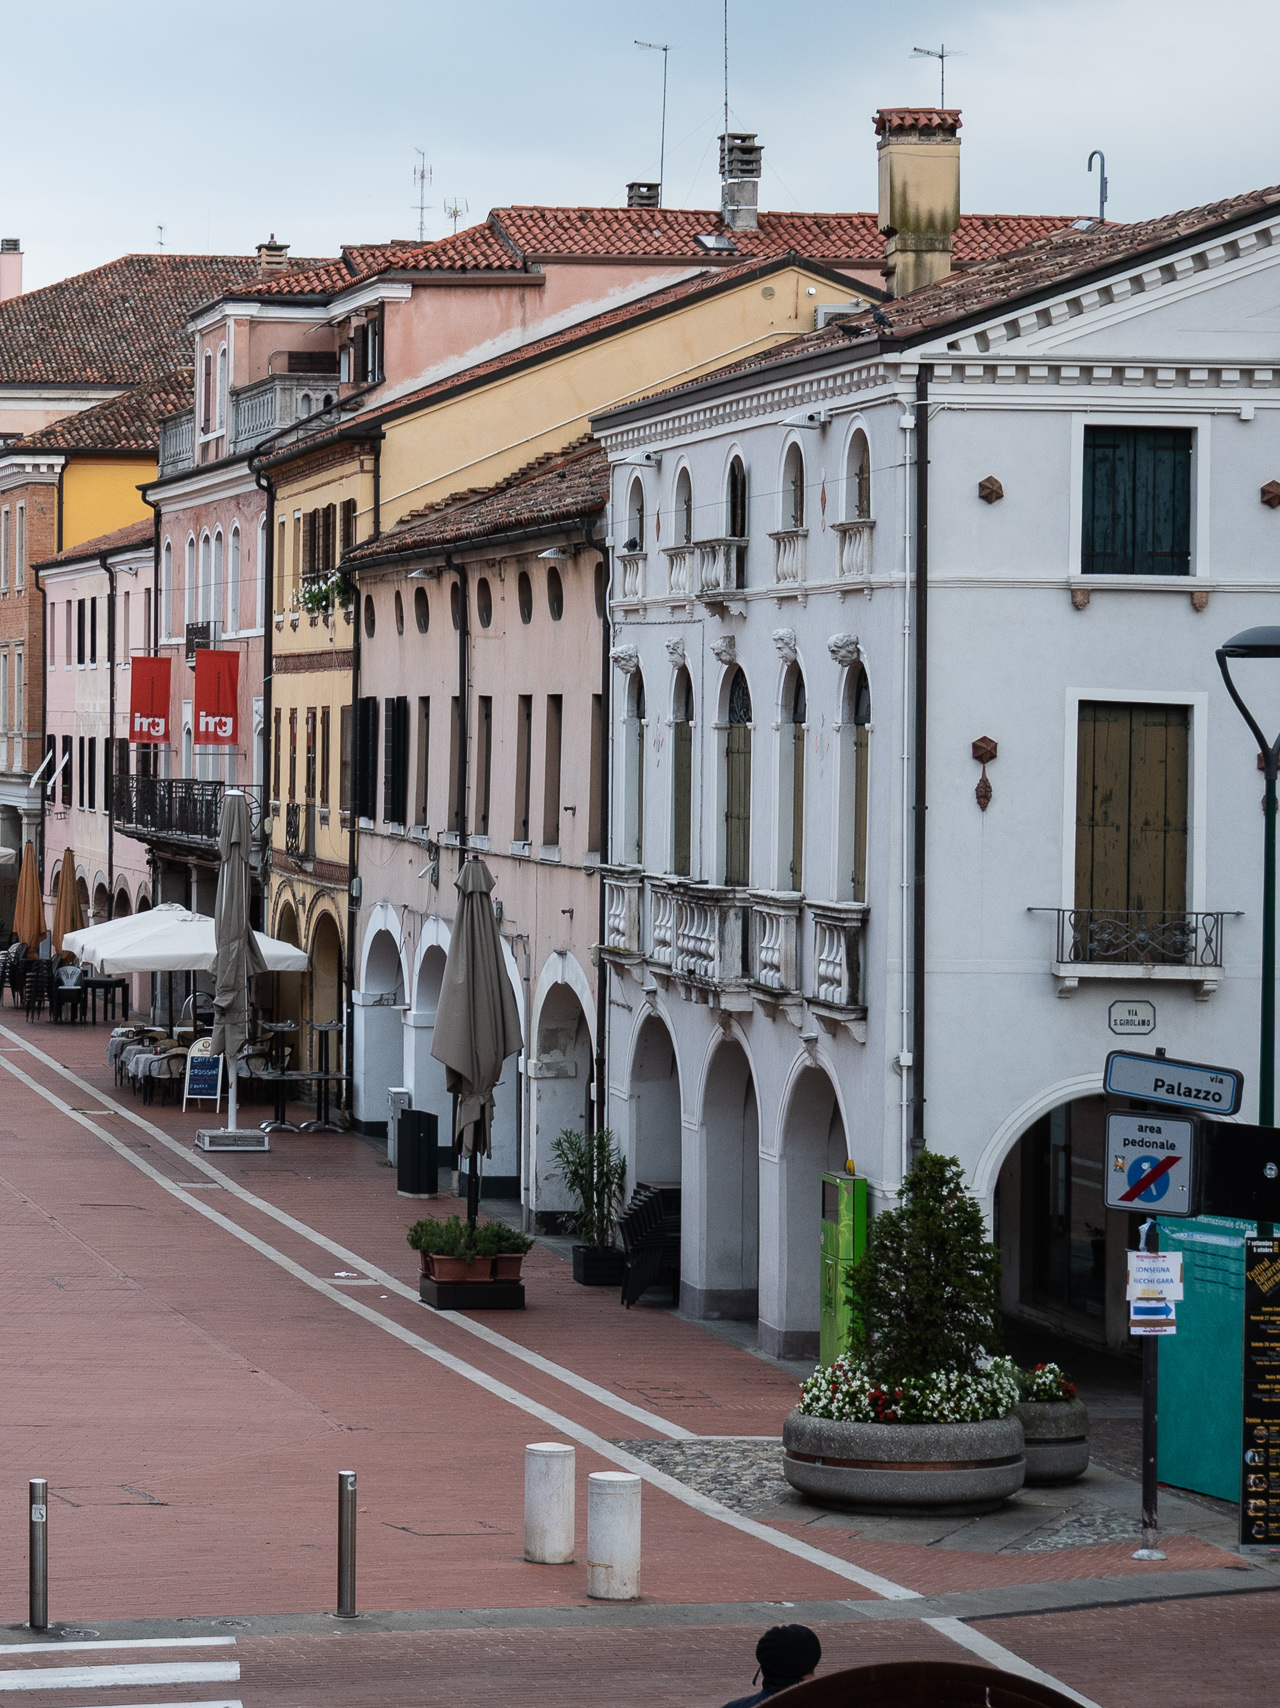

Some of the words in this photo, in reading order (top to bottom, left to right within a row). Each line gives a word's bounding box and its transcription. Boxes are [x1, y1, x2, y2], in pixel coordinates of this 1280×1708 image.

[1127, 1009, 1138, 1017] VIA
[1209, 1075, 1224, 1084] via
[1153, 1078, 1223, 1103] Palazzo
[1137, 1124, 1162, 1134] area
[1122, 1137, 1176, 1151] pedonale
[1135, 1266, 1171, 1274] CONSEGNA
[1246, 1257, 1271, 1281] Festival
